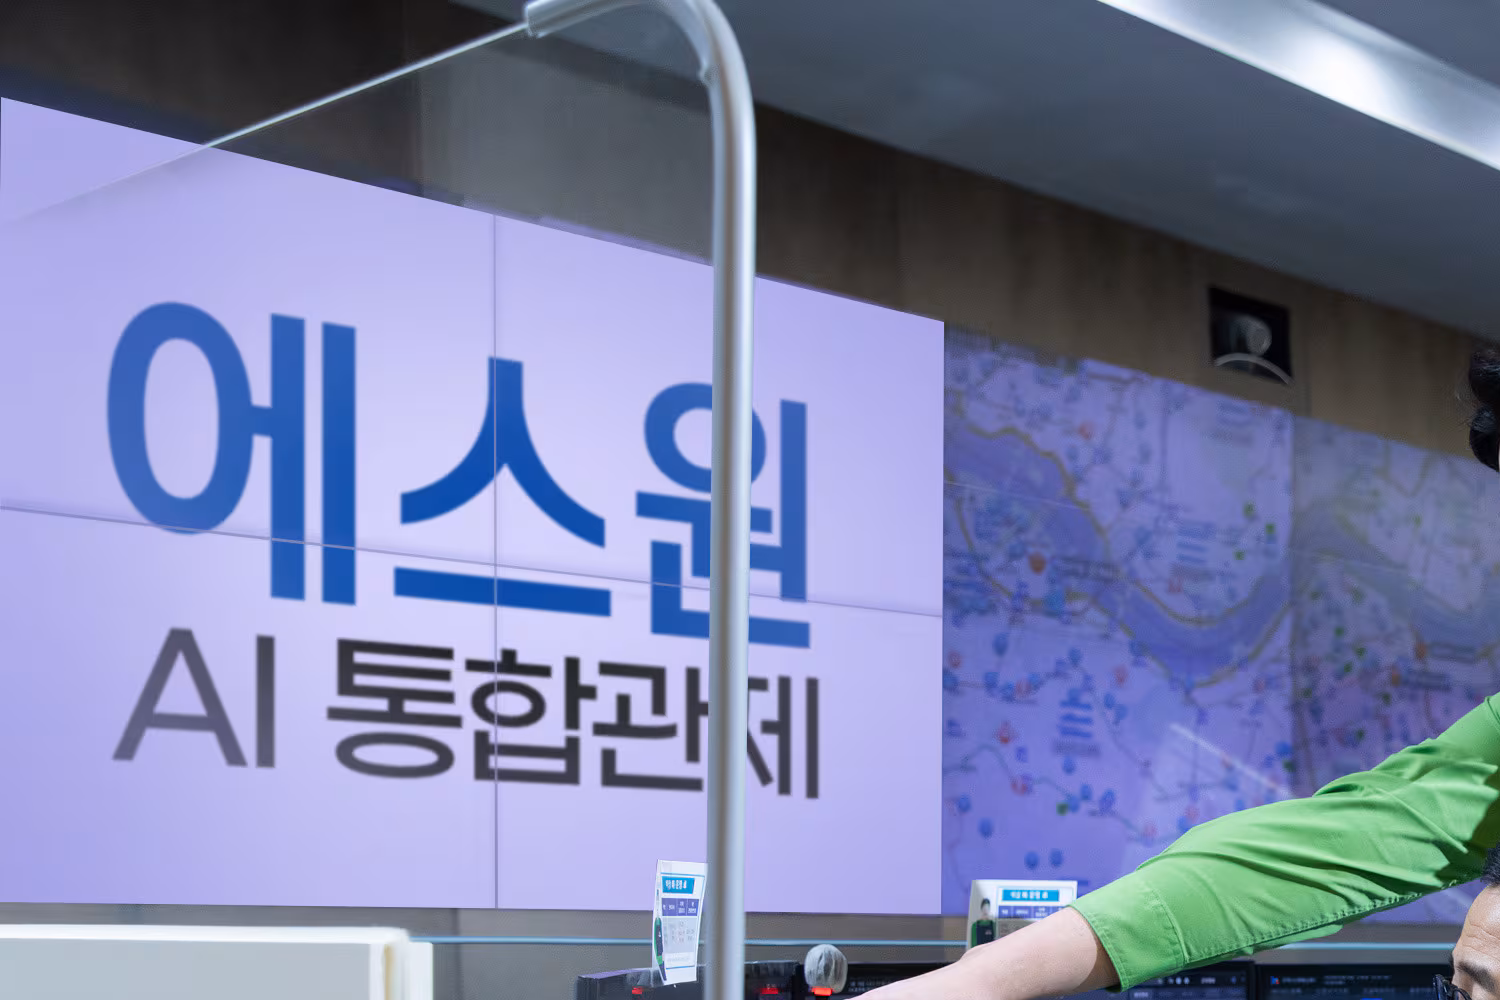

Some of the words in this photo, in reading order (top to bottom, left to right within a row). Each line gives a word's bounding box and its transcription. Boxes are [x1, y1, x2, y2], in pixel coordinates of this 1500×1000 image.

[107, 302, 811, 649] 에스원
[111, 627, 276, 770] AI
[326, 638, 819, 800] 통합관제
